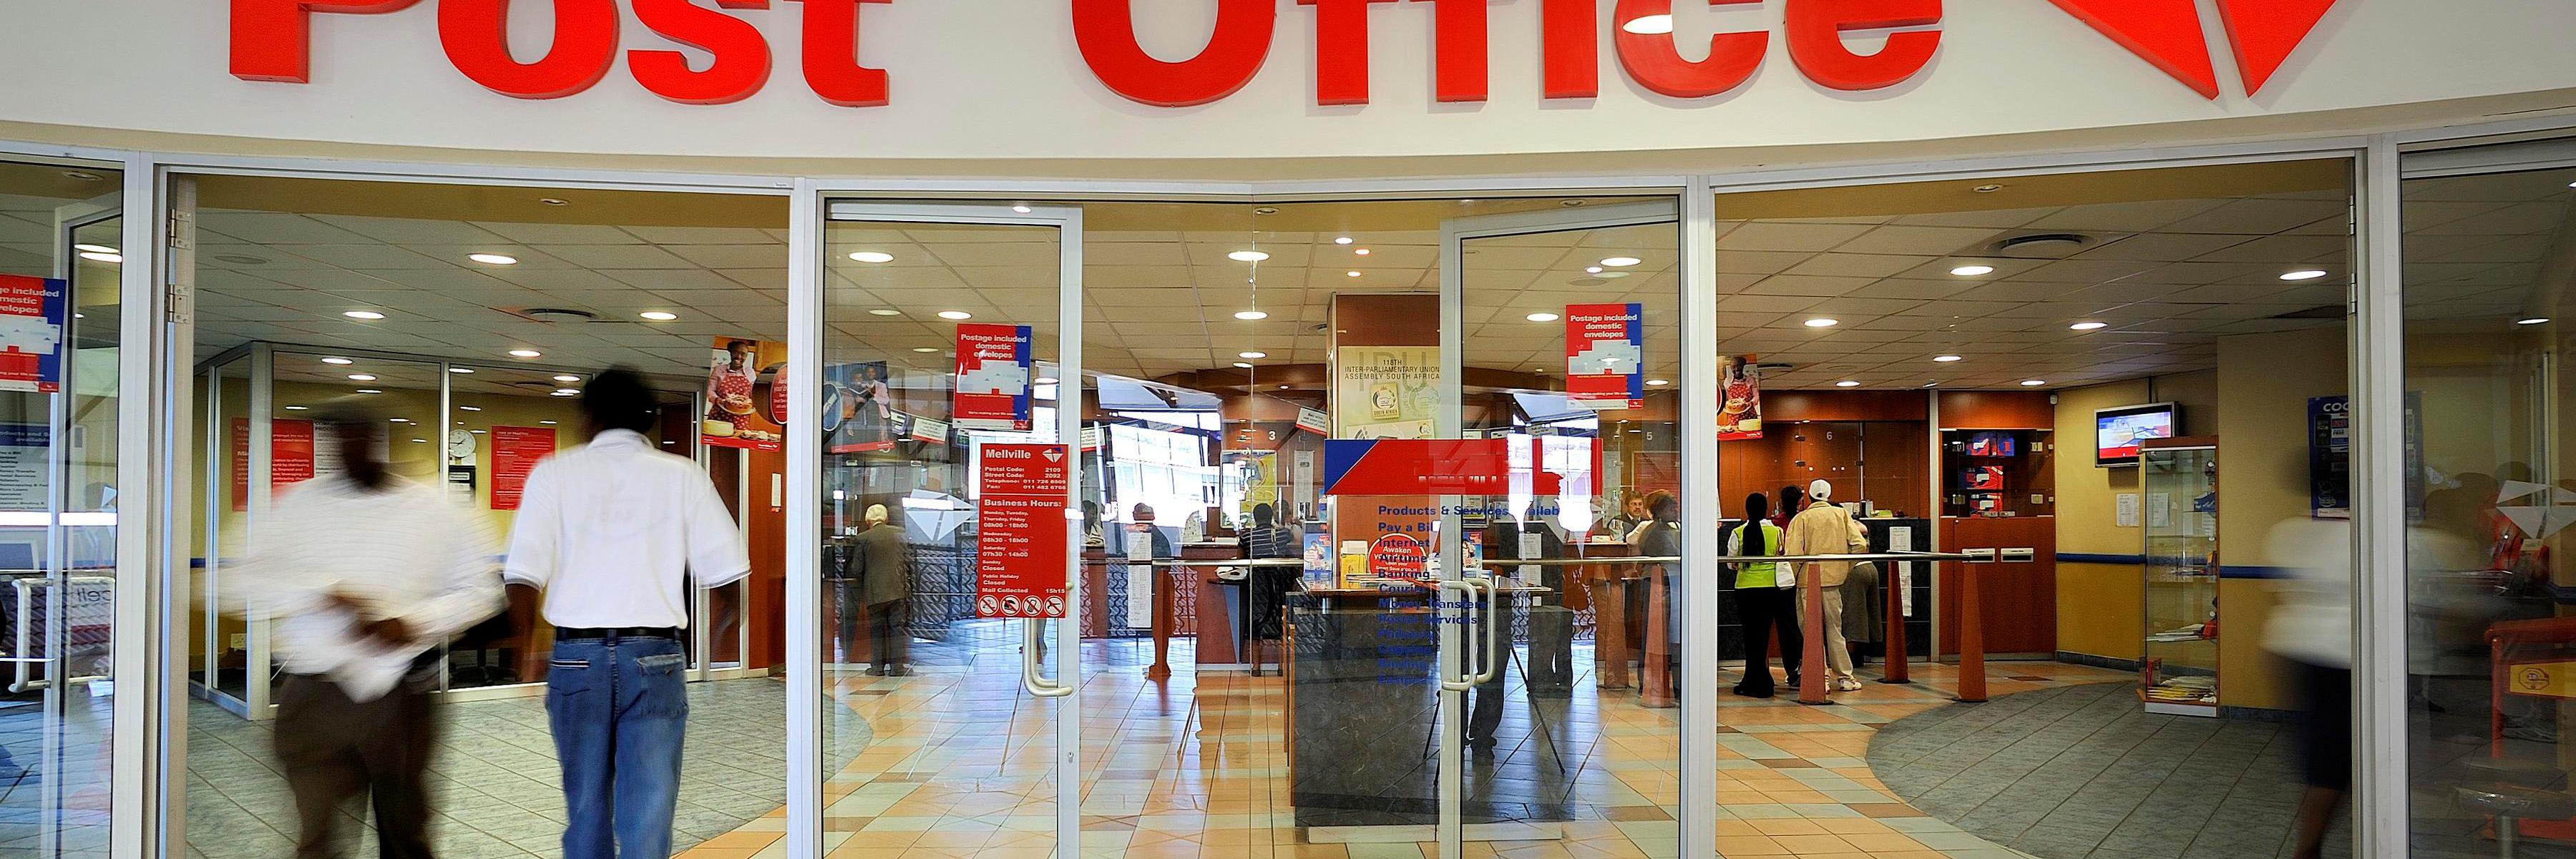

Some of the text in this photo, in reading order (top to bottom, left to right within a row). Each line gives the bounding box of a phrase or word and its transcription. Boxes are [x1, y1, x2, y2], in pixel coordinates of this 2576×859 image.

[1072, 0, 1943, 109] Office
[12, 287, 59, 298] included
[960, 334, 992, 343] Postage
[1268, 431, 1277, 441] 3
[1646, 431, 1654, 441] 5
[1826, 431, 1833, 441] 6
[985, 449, 1031, 459] Mellville
[1378, 506, 1437, 516] Products
[1441, 506, 1450, 516] &
[1453, 506, 1510, 516] Services
[1378, 522, 1402, 533] Pay
[1418, 522, 1434, 531] Bil
[1379, 539, 1430, 548] Internet
[1379, 554, 1428, 564] Airtime
[1378, 569, 1430, 580] Banking
[1379, 599, 1422, 609] Money
